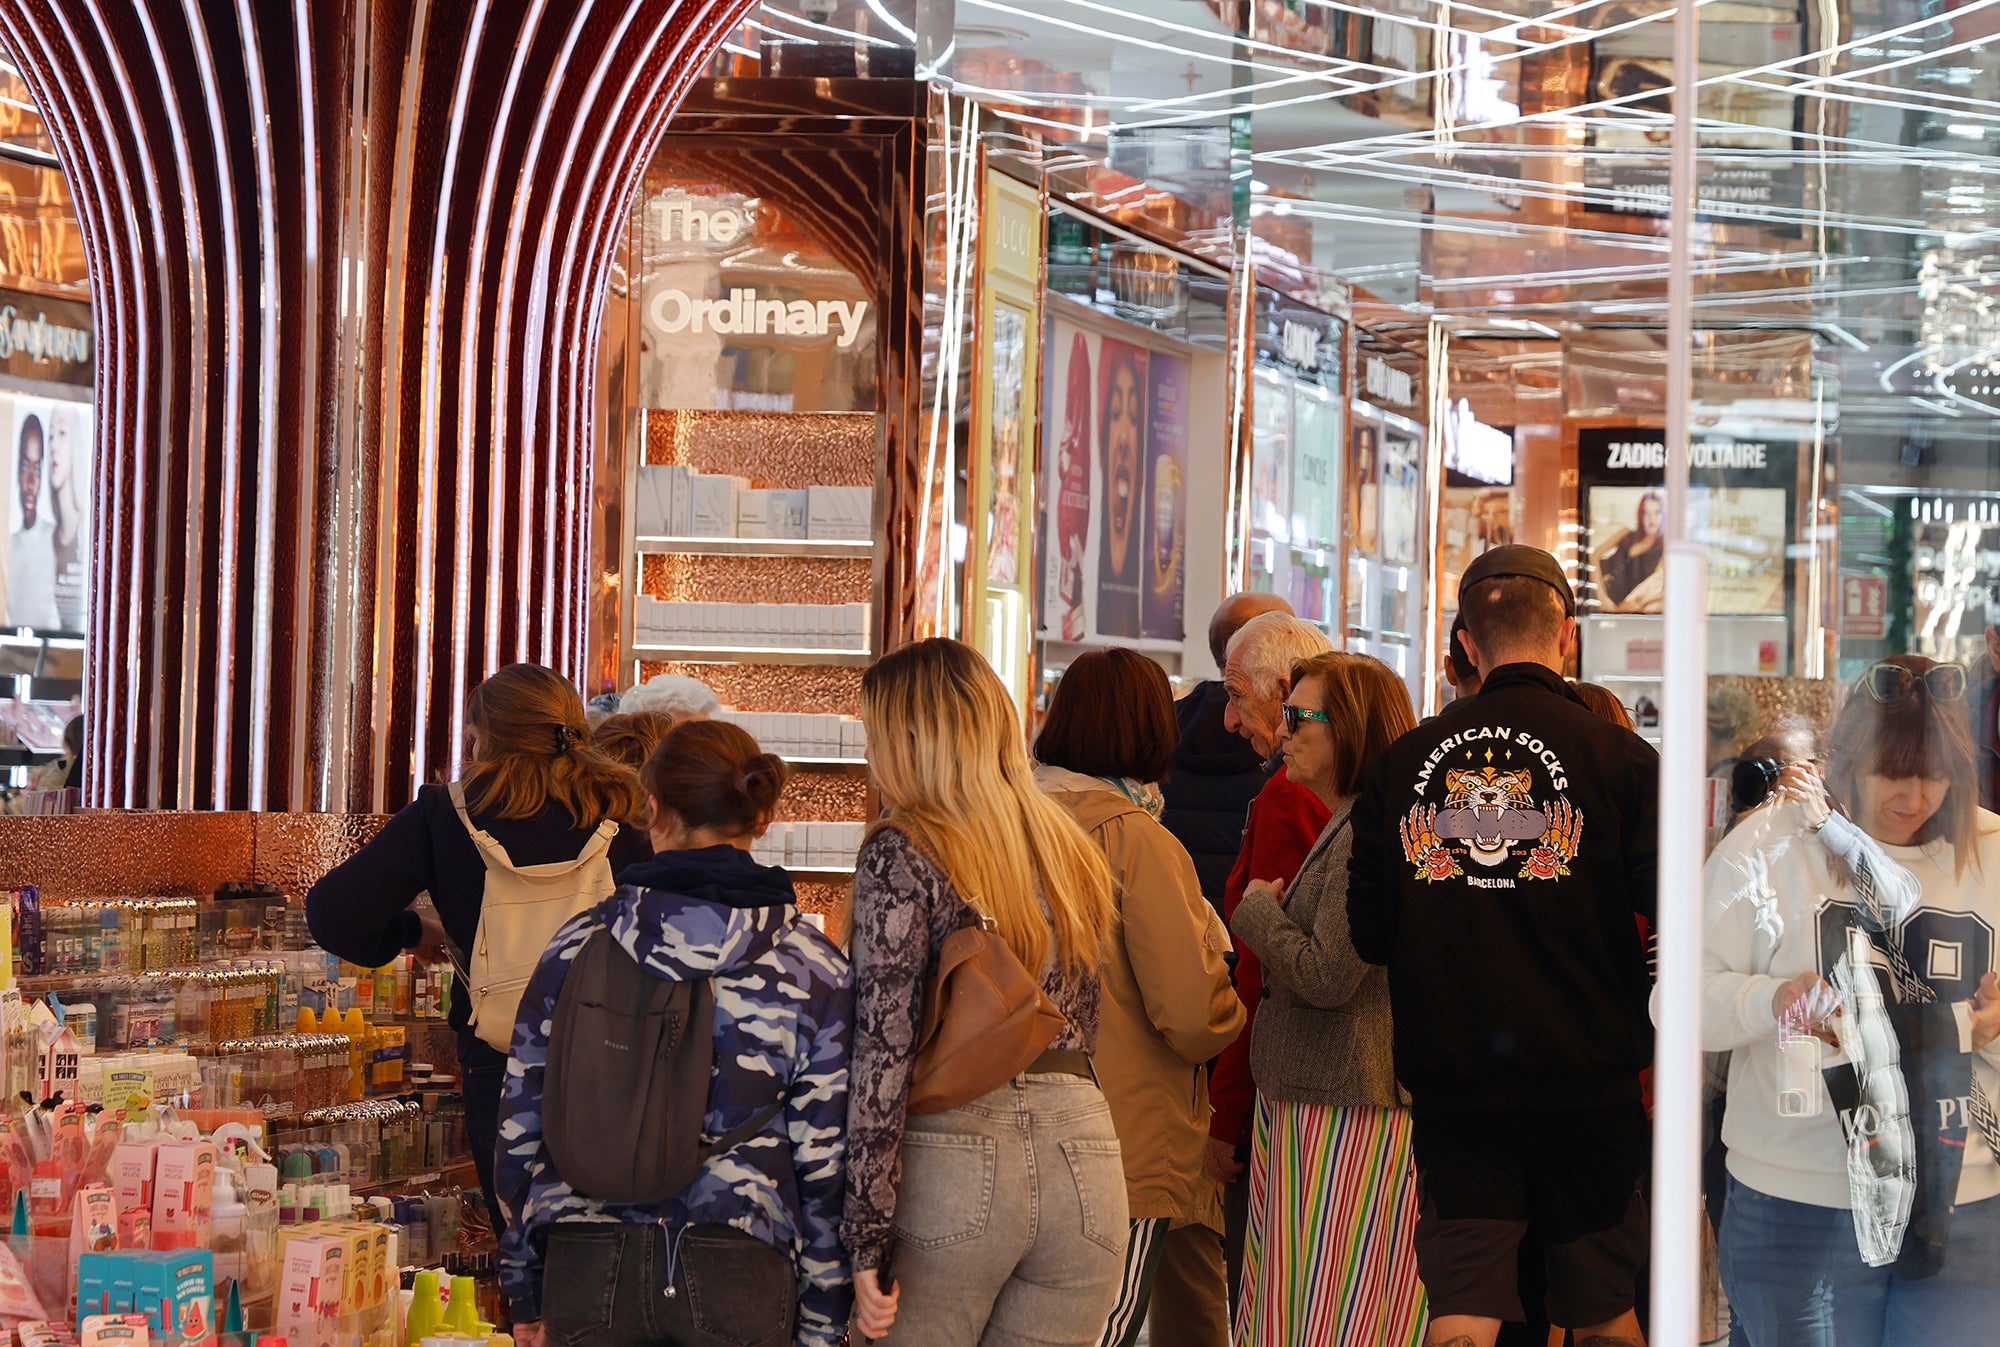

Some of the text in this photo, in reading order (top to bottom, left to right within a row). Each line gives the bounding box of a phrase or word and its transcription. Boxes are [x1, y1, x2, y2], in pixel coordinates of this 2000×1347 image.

[650, 200, 739, 242] The
[650, 288, 868, 348] Ordinary
[1607, 442, 1664, 469] ZADIG
[1413, 726, 1569, 796] AMERICAN SOCKS
